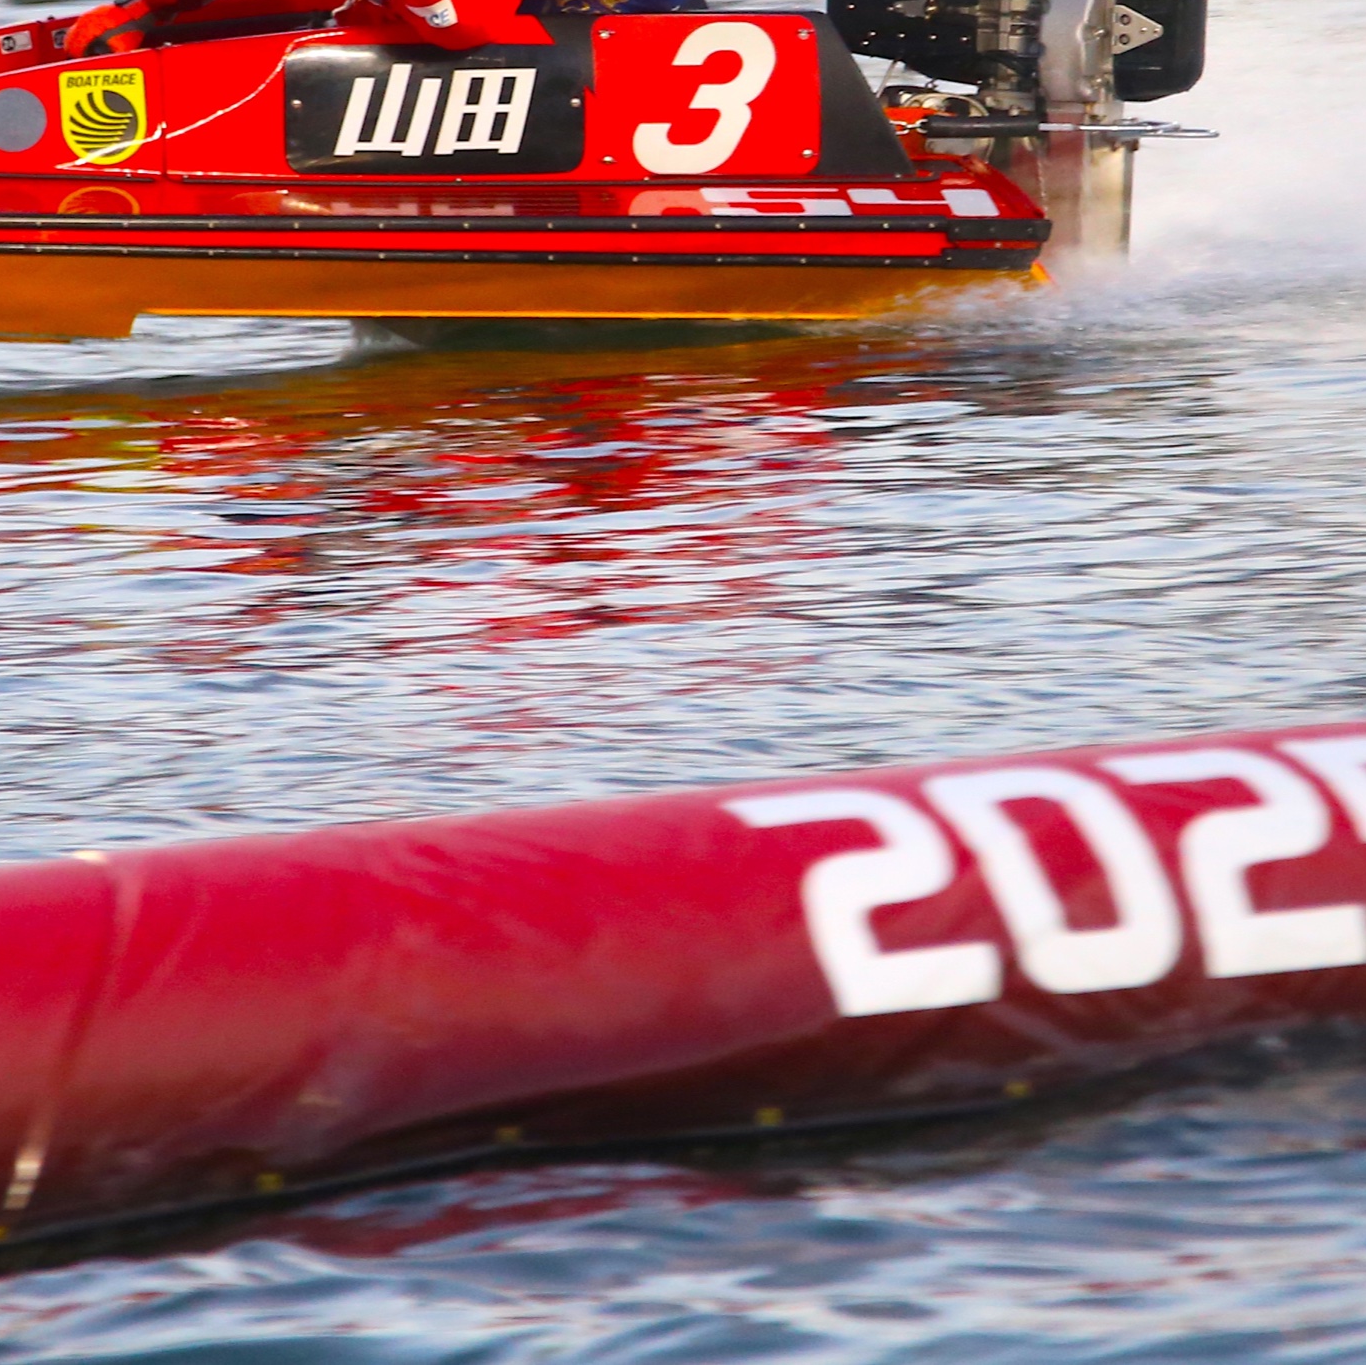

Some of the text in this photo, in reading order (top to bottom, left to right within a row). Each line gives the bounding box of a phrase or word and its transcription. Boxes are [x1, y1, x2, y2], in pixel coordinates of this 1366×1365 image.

[66, 73, 137, 89] BOAT RACE
[333, 63, 537, 157] 山田
[633, 21, 777, 175] 3
